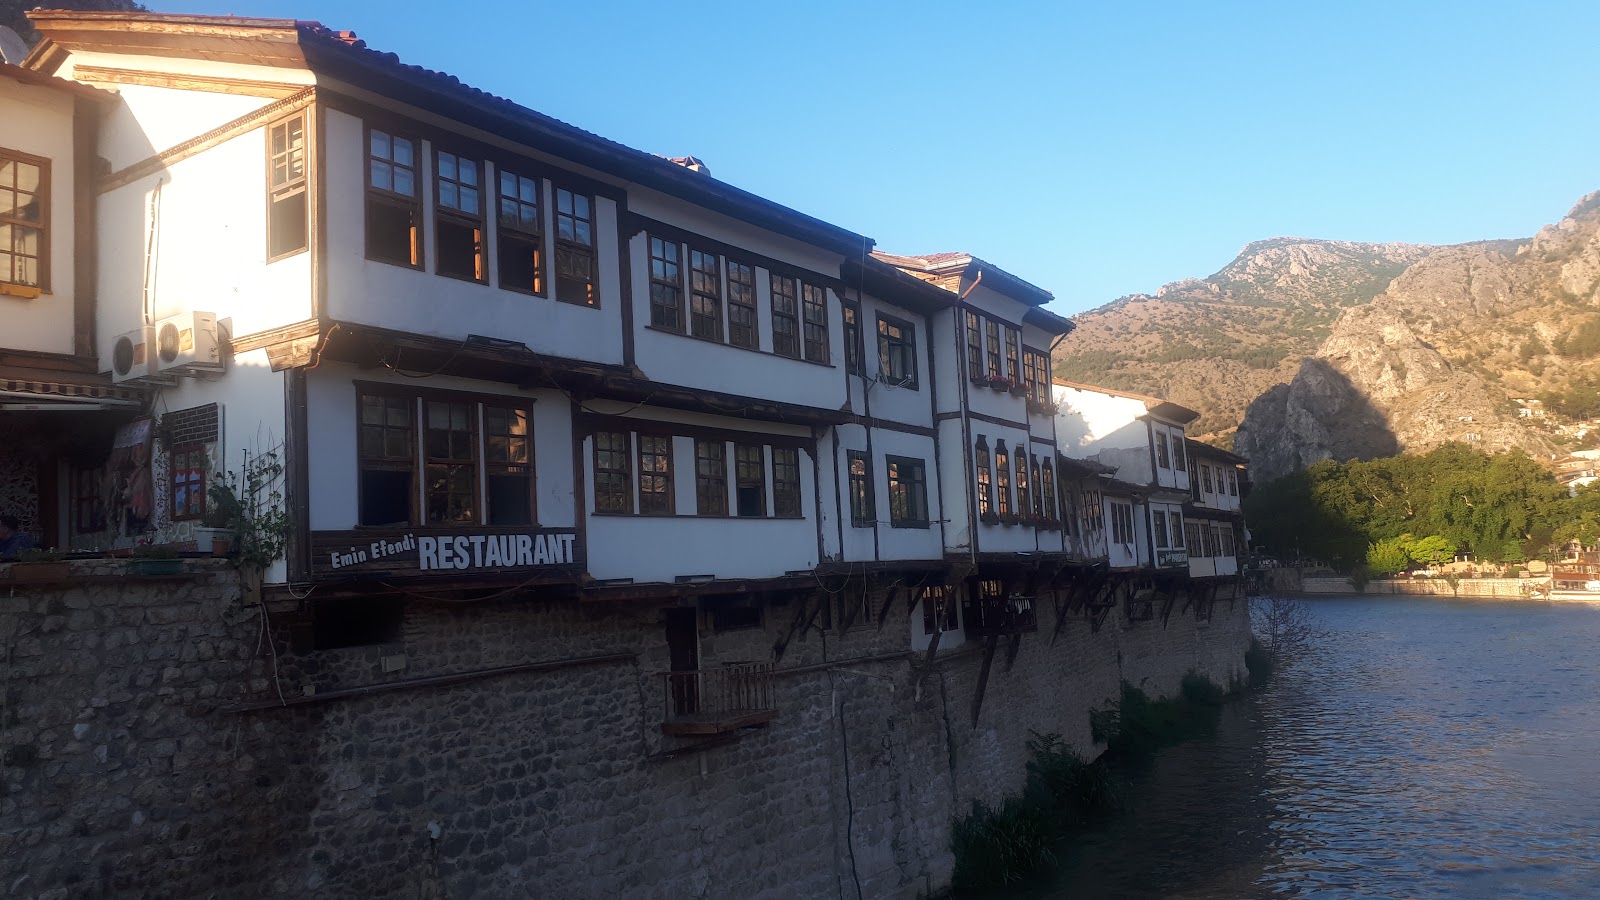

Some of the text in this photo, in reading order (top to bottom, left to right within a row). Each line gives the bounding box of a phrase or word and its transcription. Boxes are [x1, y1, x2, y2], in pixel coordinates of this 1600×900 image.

[331, 533, 576, 571] Emin Efendi RESTAURANT
